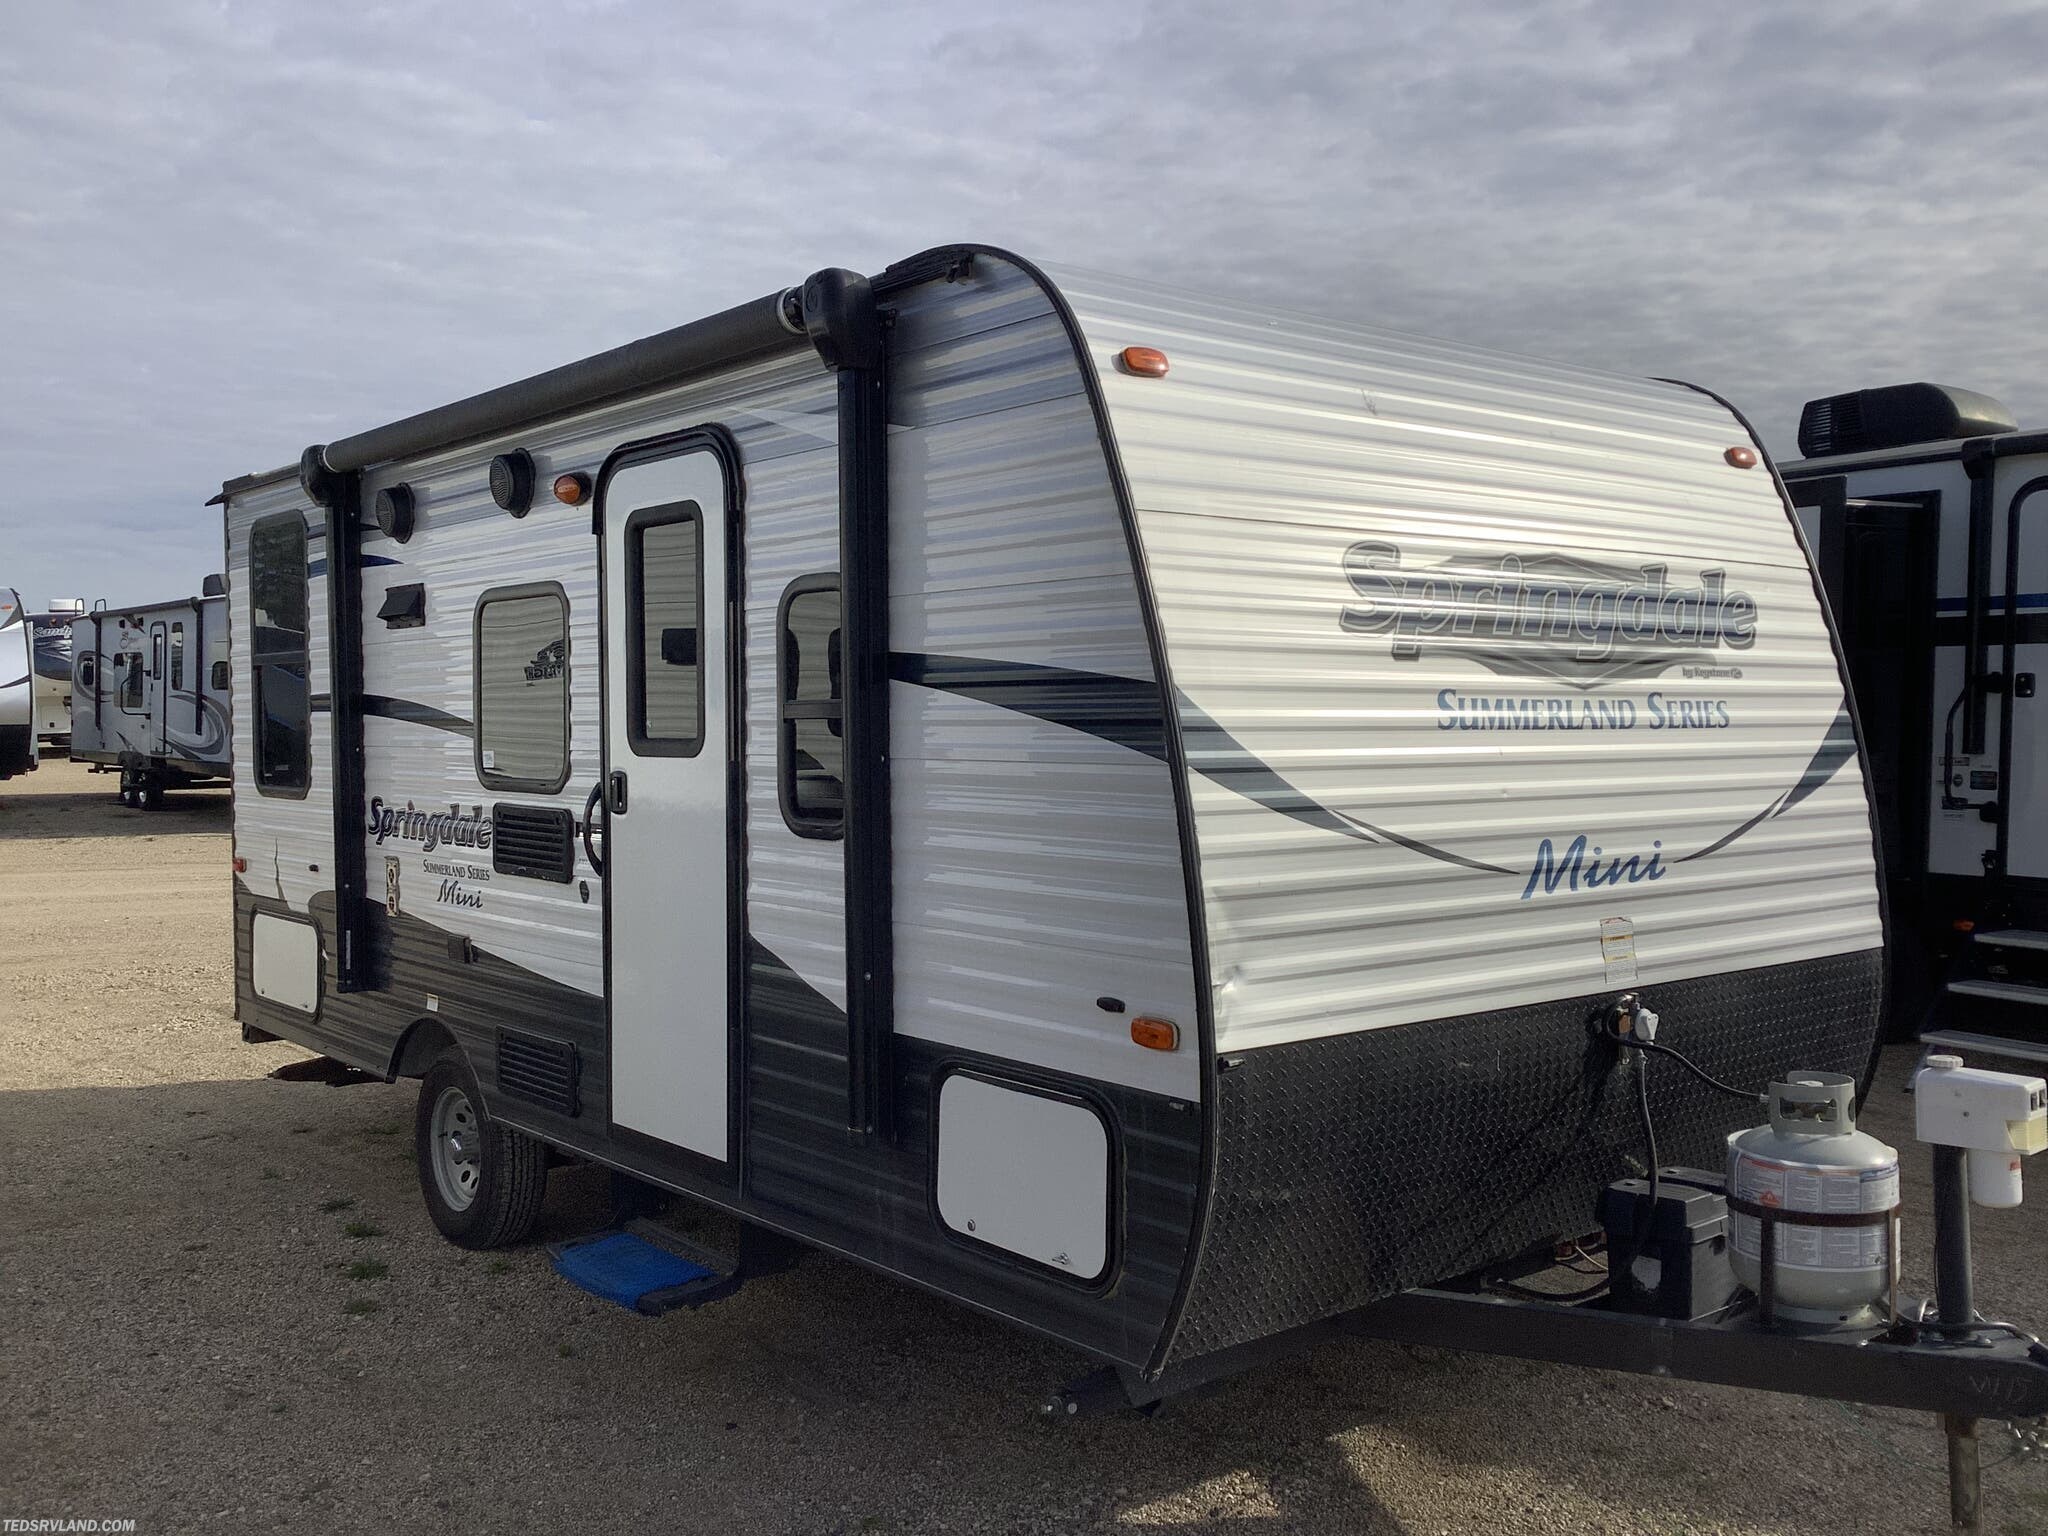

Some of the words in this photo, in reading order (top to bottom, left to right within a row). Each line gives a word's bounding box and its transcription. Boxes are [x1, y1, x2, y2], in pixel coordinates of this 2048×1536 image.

[1339, 539, 1759, 662] Springdale
[1436, 688, 1637, 731] SUMMERLAND
[1647, 691, 1730, 730] SERIES
[368, 796, 492, 852] Springdale
[422, 859, 466, 878] SUMMERLAND
[467, 864, 490, 881] SERIES
[1520, 834, 1667, 900] Mini
[437, 878, 483, 909] Mini
